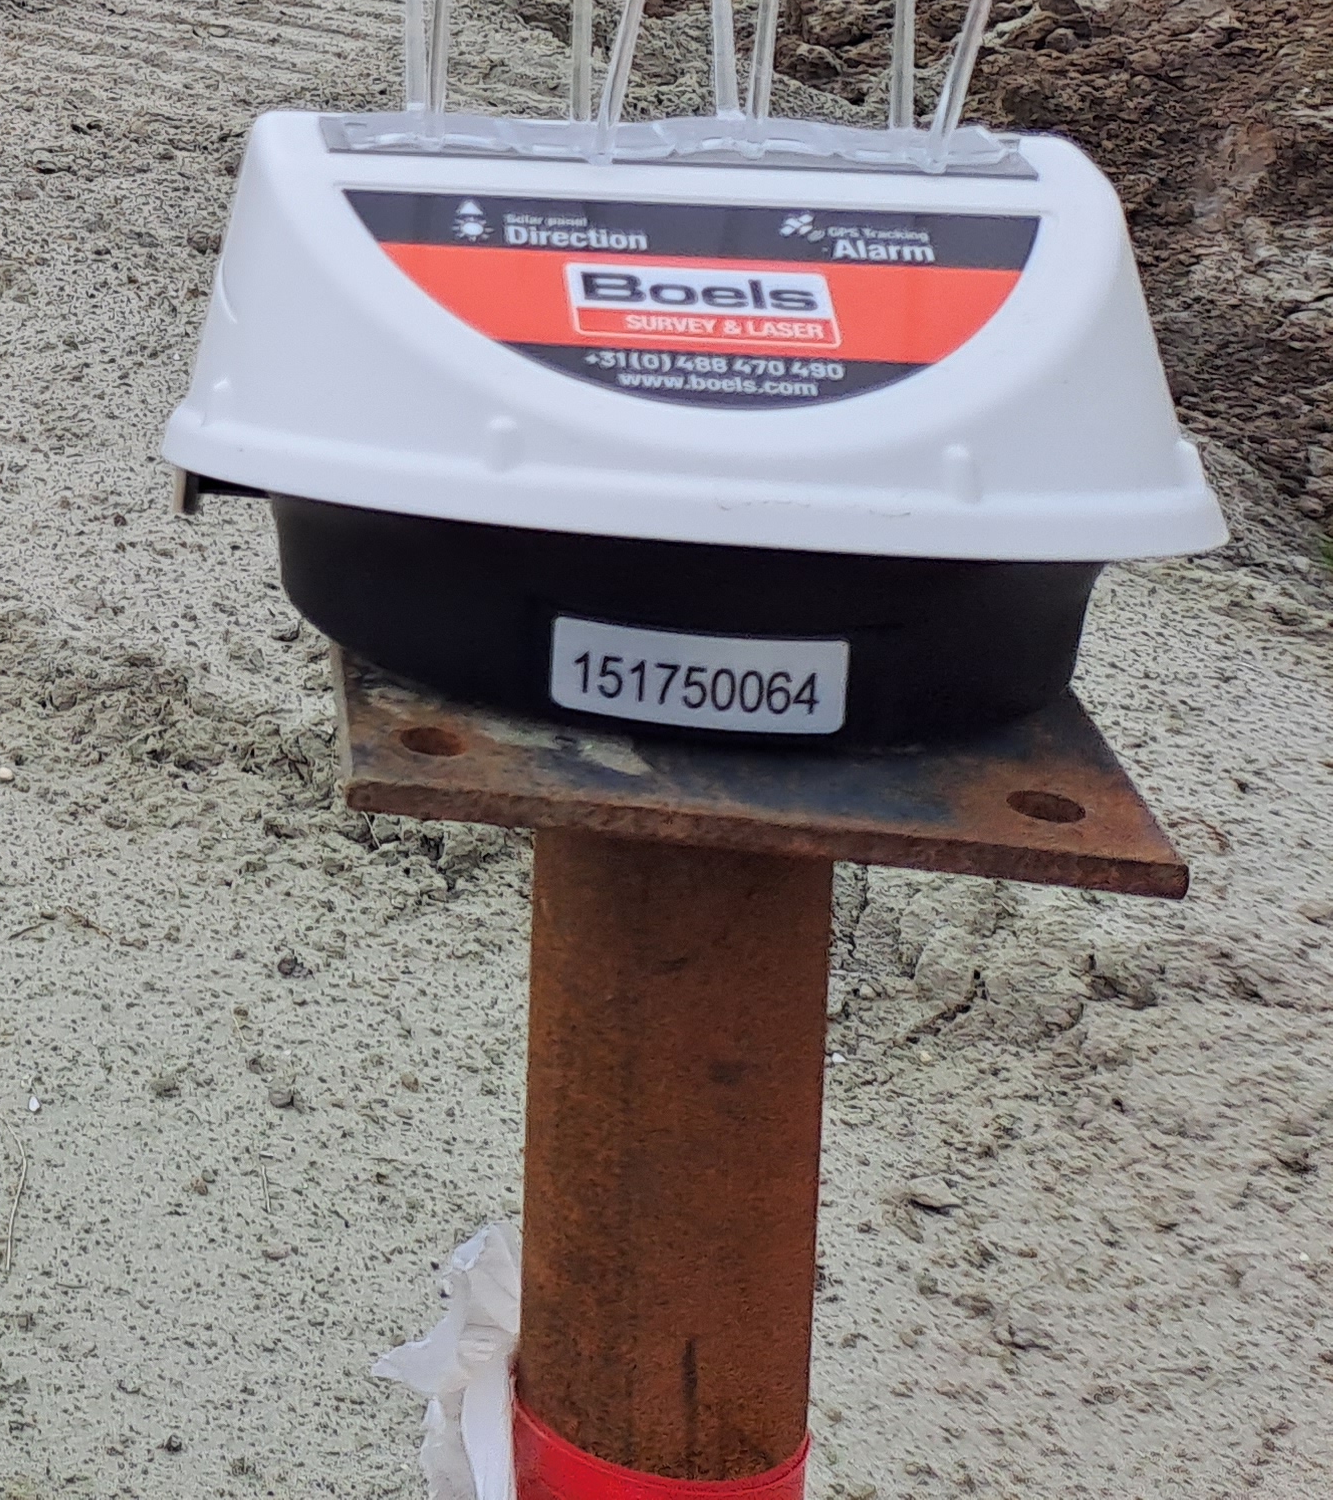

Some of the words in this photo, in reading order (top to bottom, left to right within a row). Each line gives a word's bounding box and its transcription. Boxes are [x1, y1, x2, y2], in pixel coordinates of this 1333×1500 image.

[506, 225, 648, 250] Direction
[827, 226, 860, 238] GPS
[862, 228, 930, 243] Tracking
[835, 239, 935, 262] Alarm
[580, 271, 819, 312] Boels
[625, 315, 716, 335] SURVEY
[723, 320, 742, 336] &
[748, 321, 824, 340] LASER
[584, 352, 671, 372] +31(0)
[735, 359, 785, 377] 470
[618, 373, 819, 396] www.boels.com
[574, 650, 821, 715] 151750064
